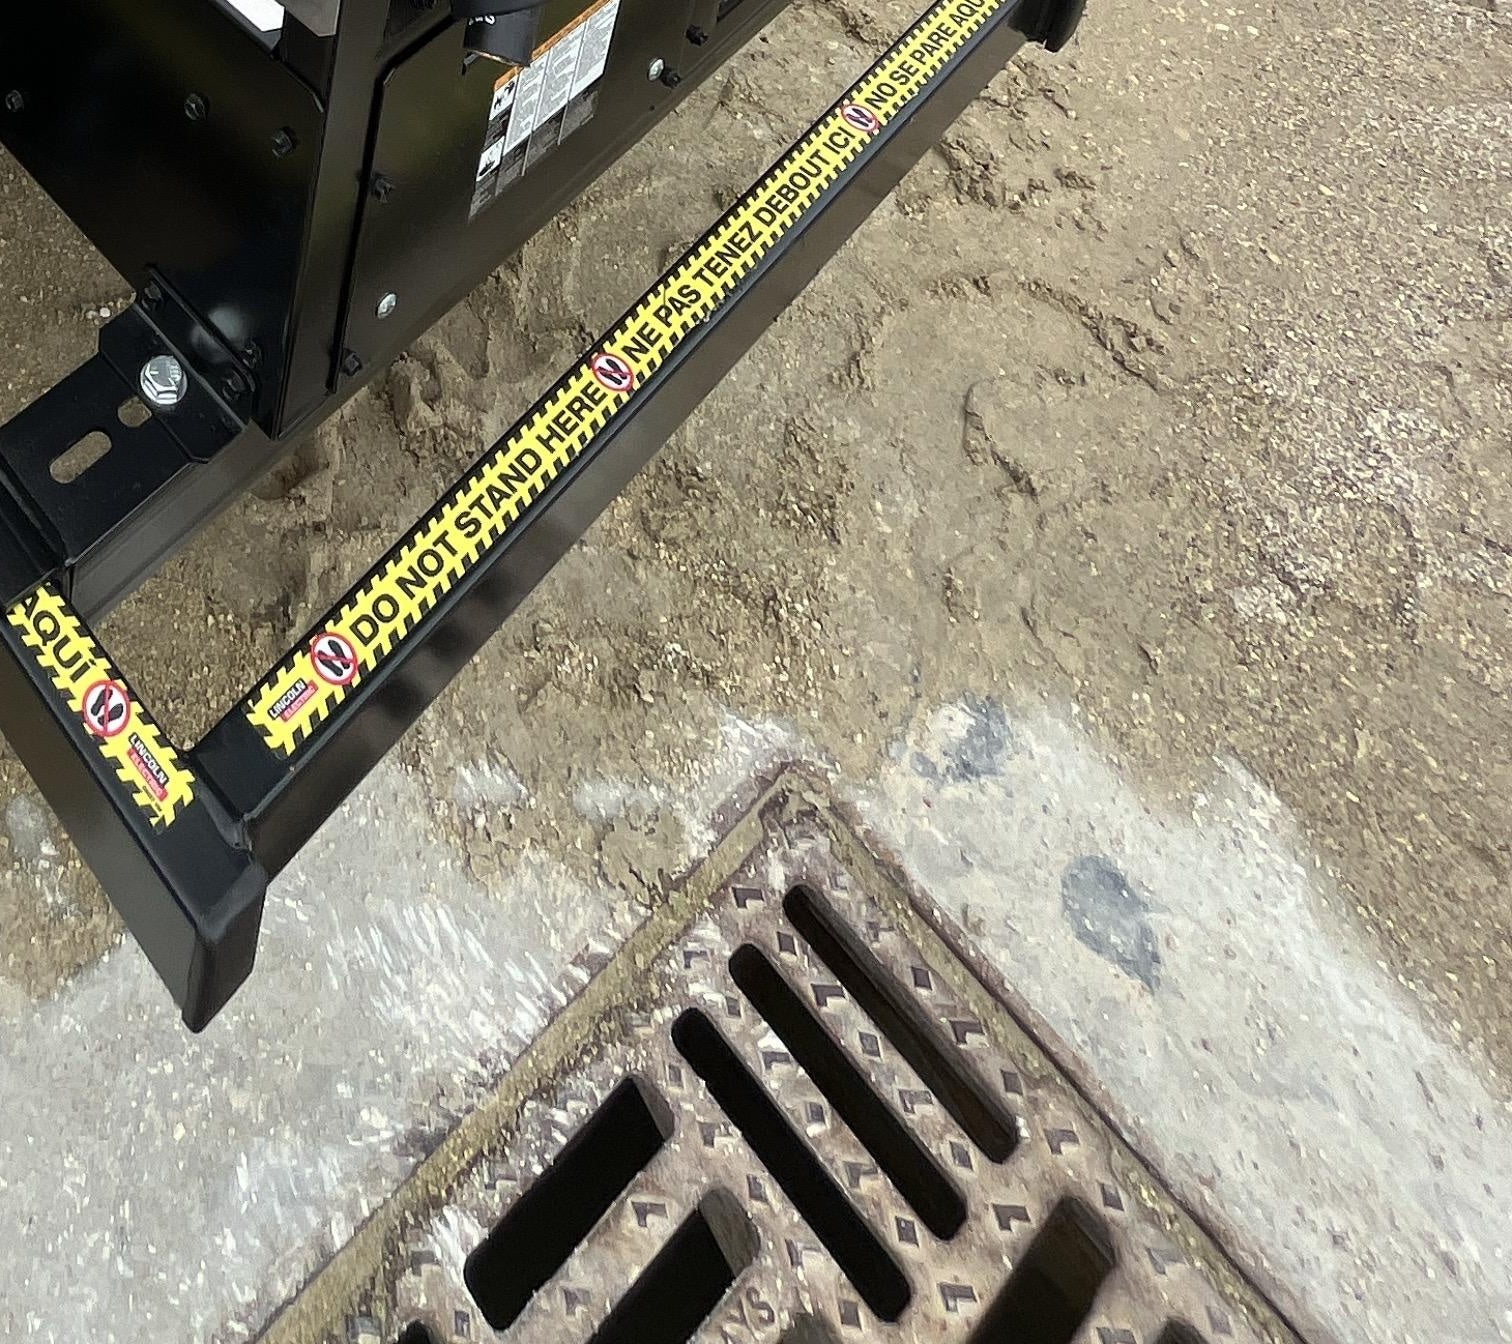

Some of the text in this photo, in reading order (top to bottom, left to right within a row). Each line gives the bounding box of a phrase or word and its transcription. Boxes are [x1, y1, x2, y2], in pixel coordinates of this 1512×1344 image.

[349, 593, 401, 649] DO
[395, 531, 460, 592] NOT
[454, 447, 543, 538] STAND
[536, 380, 608, 455] HERE
[621, 322, 664, 365] NE
[653, 283, 702, 330] PAS
[691, 219, 763, 289] TENEZ
[752, 151, 830, 228] DEBOUT
[822, 125, 856, 157] ICI
[864, 81, 899, 111] NO
[888, 59, 920, 86] SE
[908, 22, 958, 67] PARE
[267, 677, 309, 720] LINCOLN
[281, 681, 320, 723] ELECTRIC
[127, 734, 170, 786] LINCOLN
[127, 749, 169, 802] ELECTRIC
